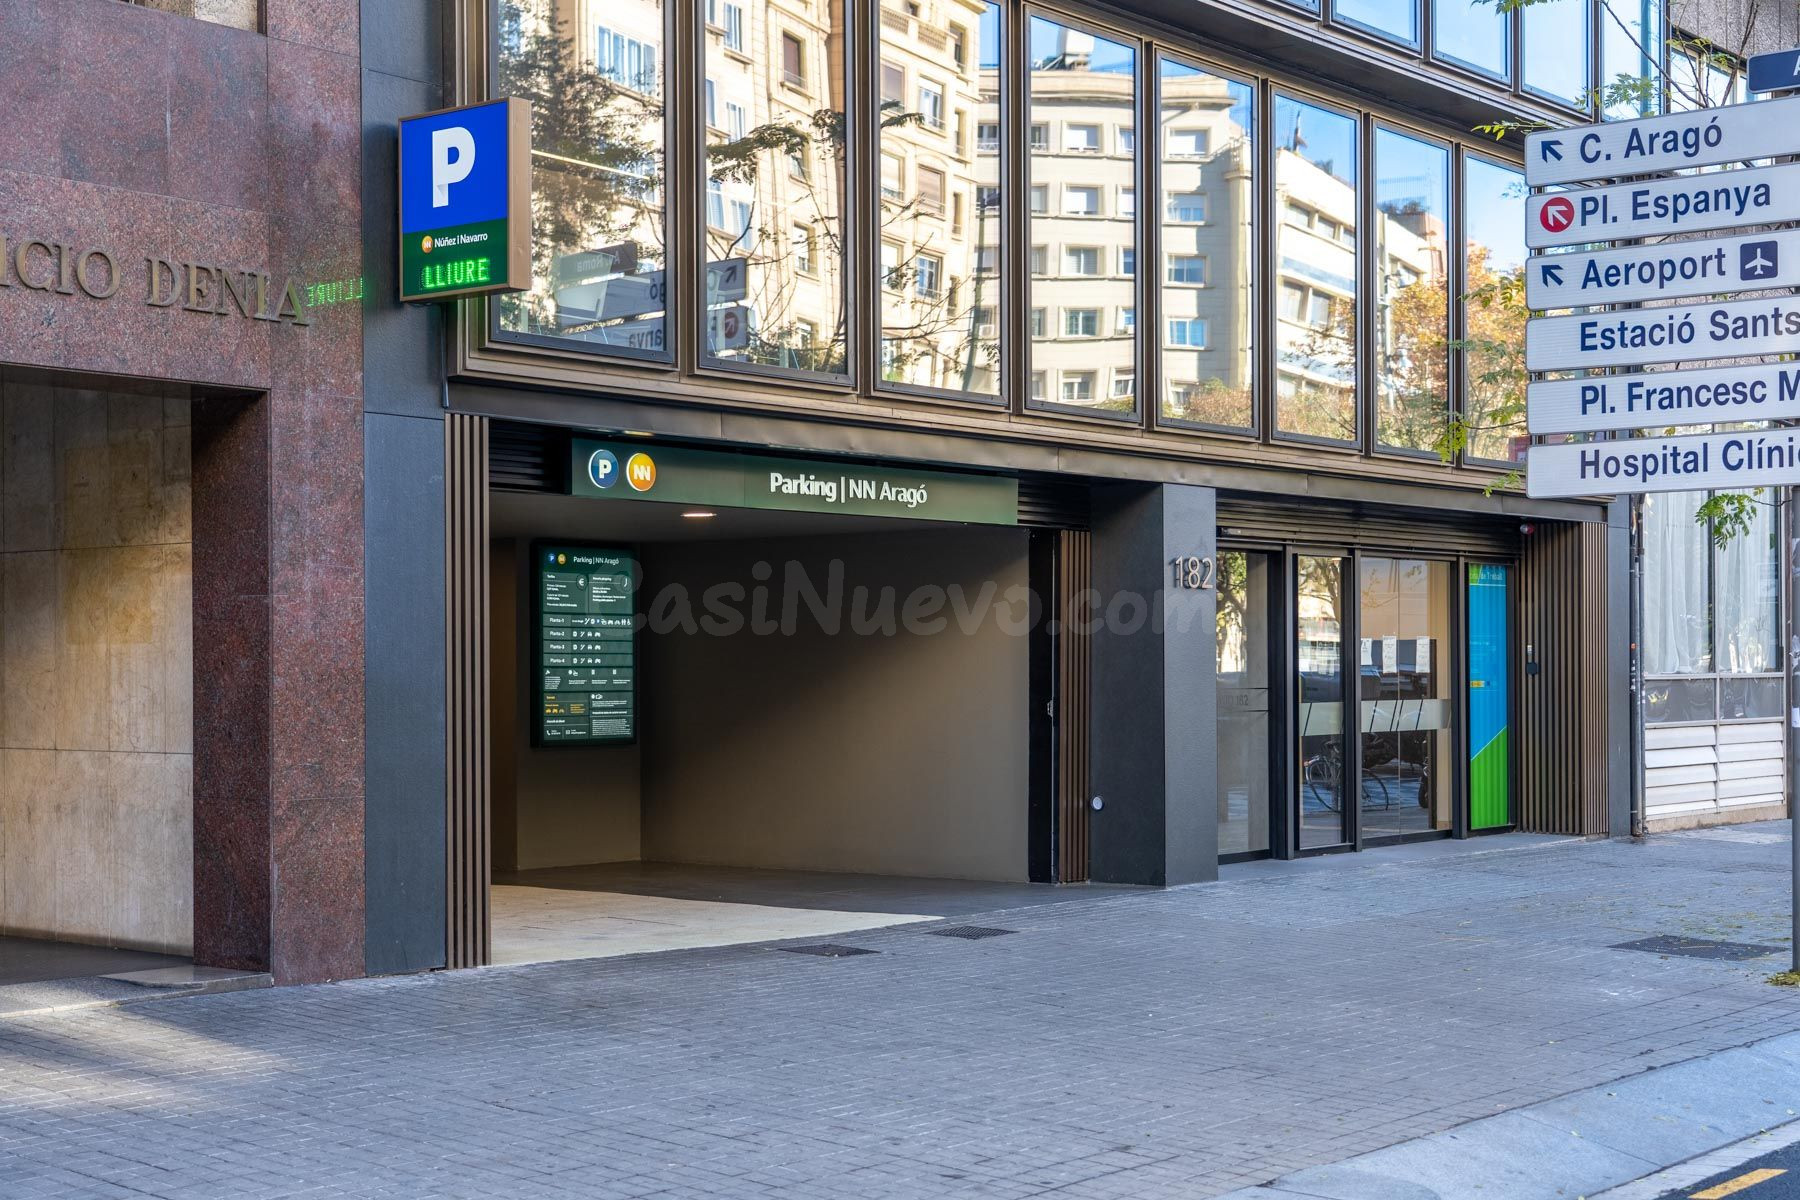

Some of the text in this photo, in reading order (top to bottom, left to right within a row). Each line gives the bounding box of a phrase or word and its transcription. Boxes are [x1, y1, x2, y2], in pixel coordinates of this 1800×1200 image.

[1580, 116, 1722, 163] C. Aragó
[432, 126, 475, 208] P
[1581, 183, 1771, 226] Pl. Espanya
[434, 237, 457, 248] Núñez
[460, 233, 488, 244] Navarro
[424, 258, 490, 289] LLIURE
[1581, 248, 1726, 289] Aeroport
[145, 257, 310, 325] DENIA
[1581, 307, 1800, 351] Estació Sants
[1581, 385, 1616, 415] Pl.
[1628, 380, 1767, 412] Francesc
[598, 459, 651, 481] P NN
[1581, 437, 1800, 482] Hospital Clíni
[770, 472, 837, 502] Parking
[849, 479, 876, 500] NN
[879, 482, 928, 508] Aragó
[573, 556, 592, 565] Parking
[1175, 555, 1213, 588] 182
